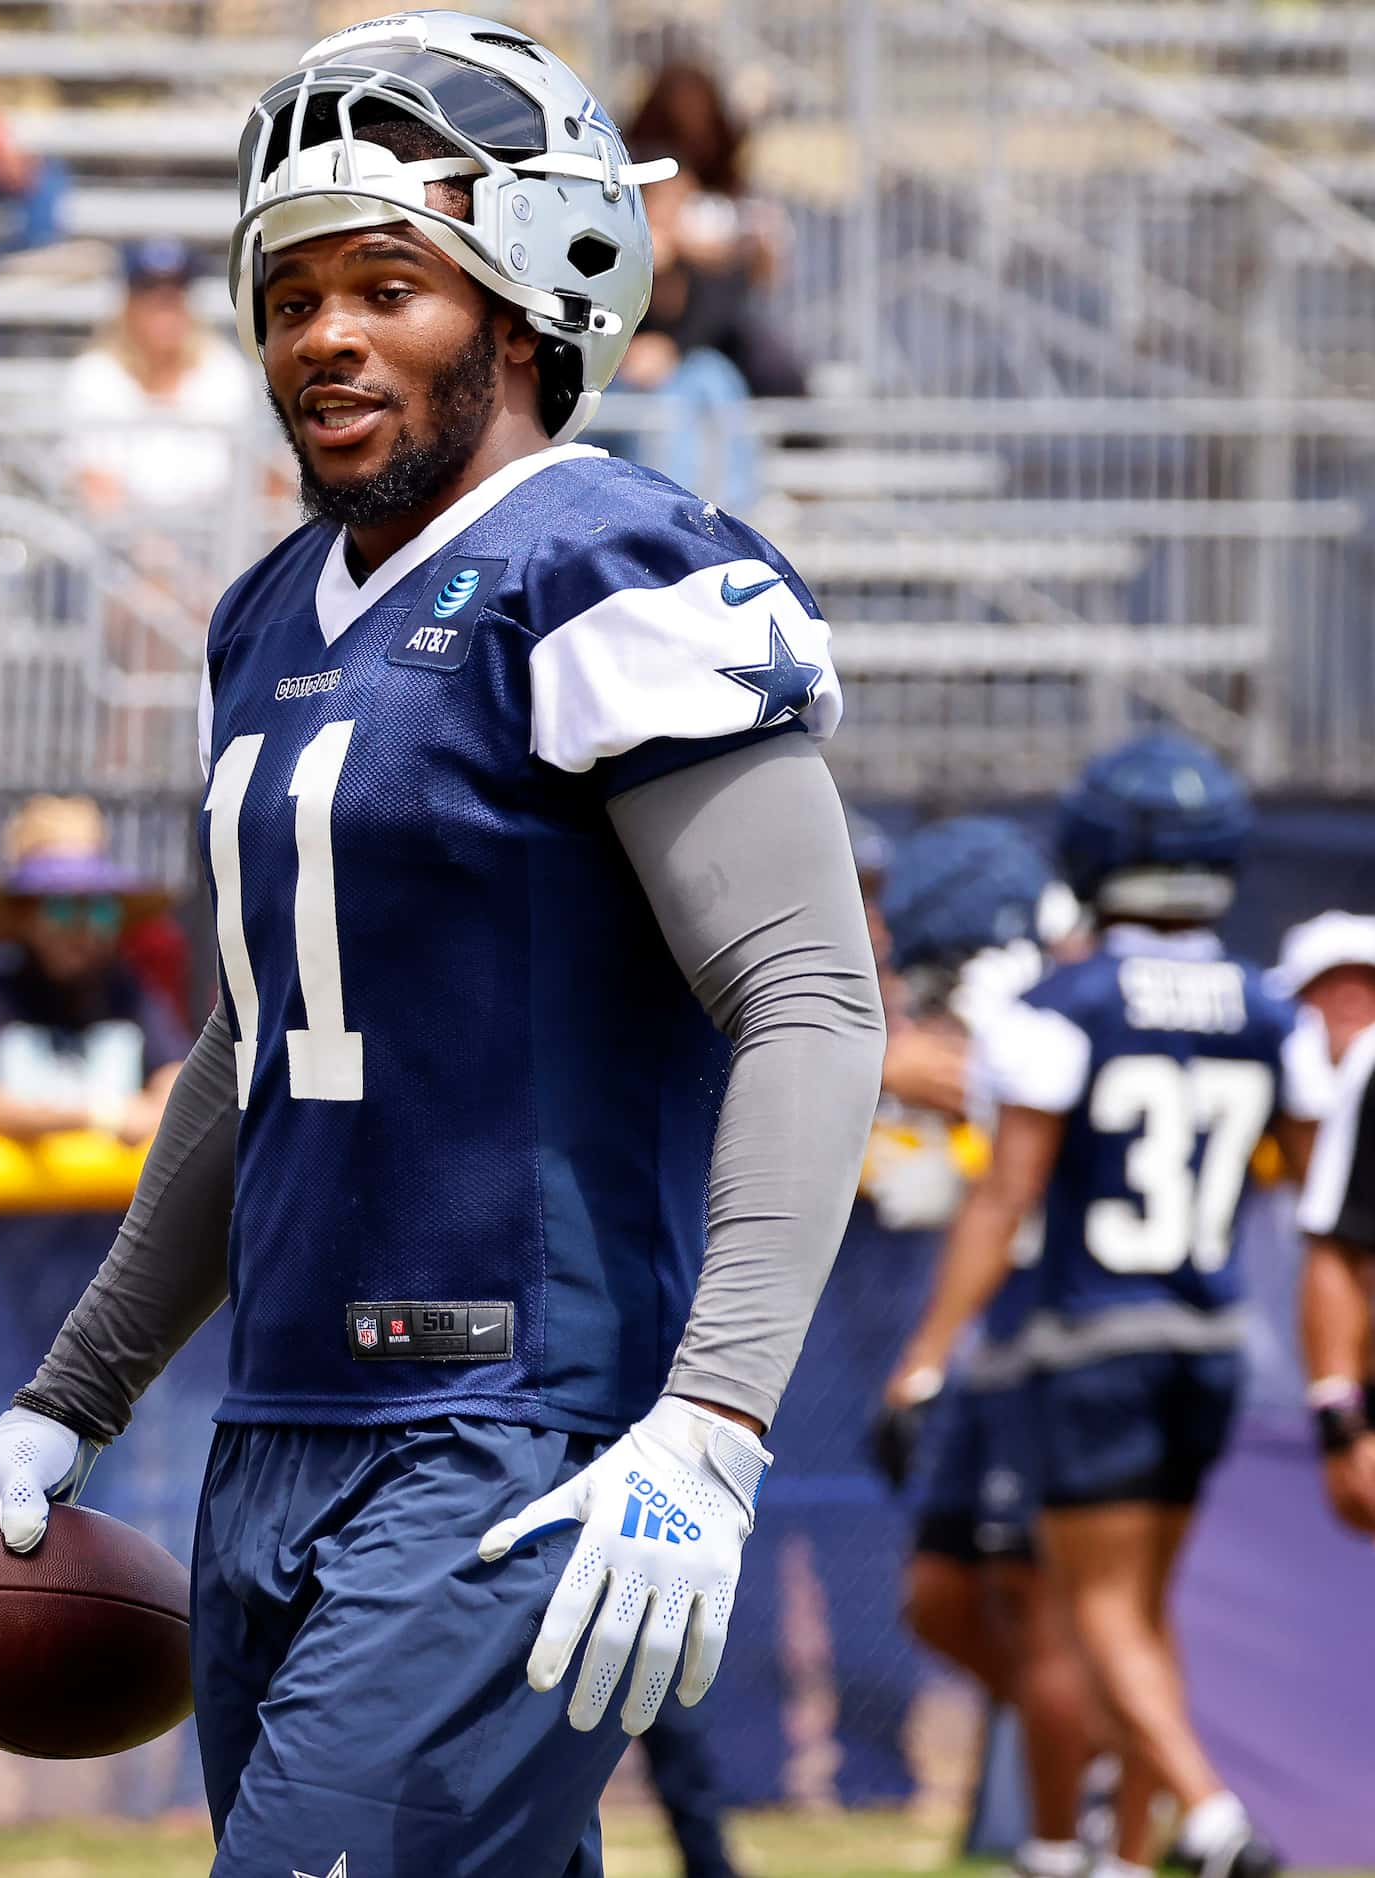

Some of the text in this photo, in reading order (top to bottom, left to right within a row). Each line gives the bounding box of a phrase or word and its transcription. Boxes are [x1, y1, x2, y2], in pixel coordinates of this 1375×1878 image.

[327, 18, 408, 42] WBOYS
[405, 626, 458, 653] AT&T
[275, 668, 342, 701] COWBOYS
[204, 719, 363, 1111] 11
[1085, 1054, 1273, 1274] 37
[424, 1311, 454, 1332] 50
[625, 1470, 701, 1541] adidas
